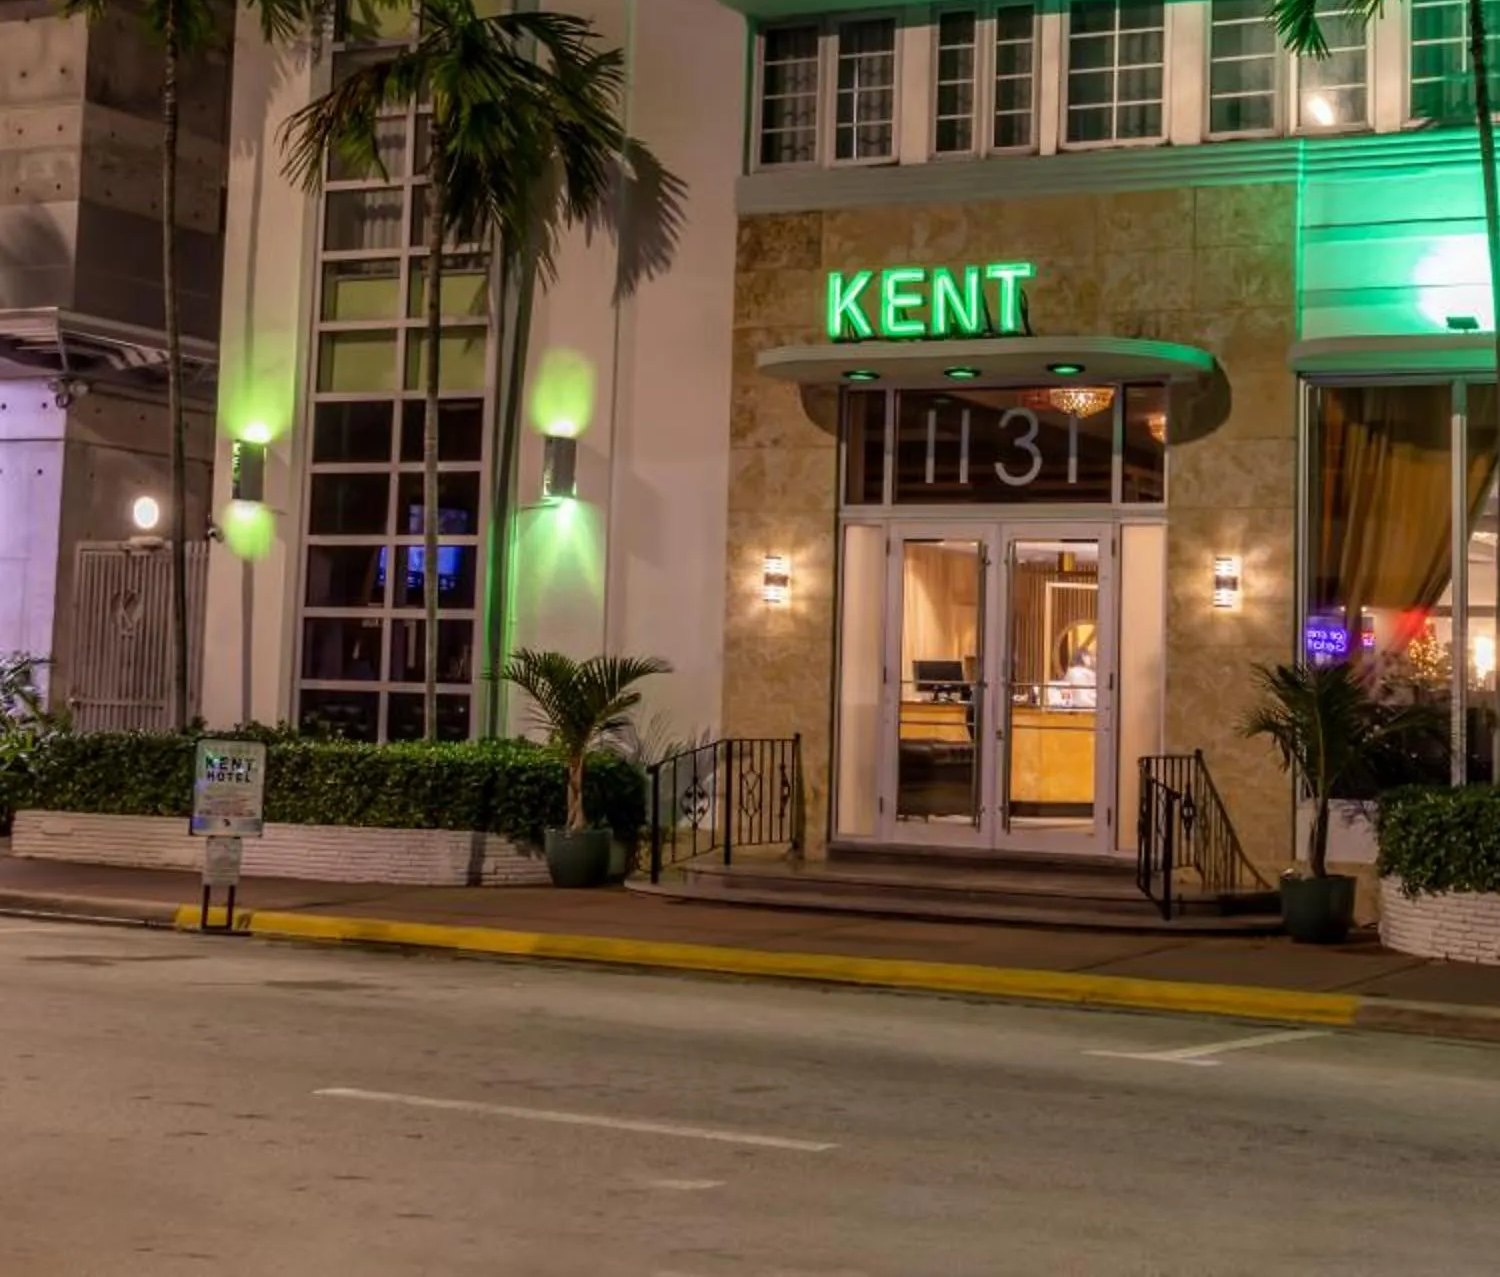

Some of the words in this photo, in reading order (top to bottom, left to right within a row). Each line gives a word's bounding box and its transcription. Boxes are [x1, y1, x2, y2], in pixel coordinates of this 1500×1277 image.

[827, 262, 1034, 339] KENT
[924, 407, 1079, 486] 1131
[204, 755, 255, 772] KENT
[205, 772, 252, 784] HOTEL
